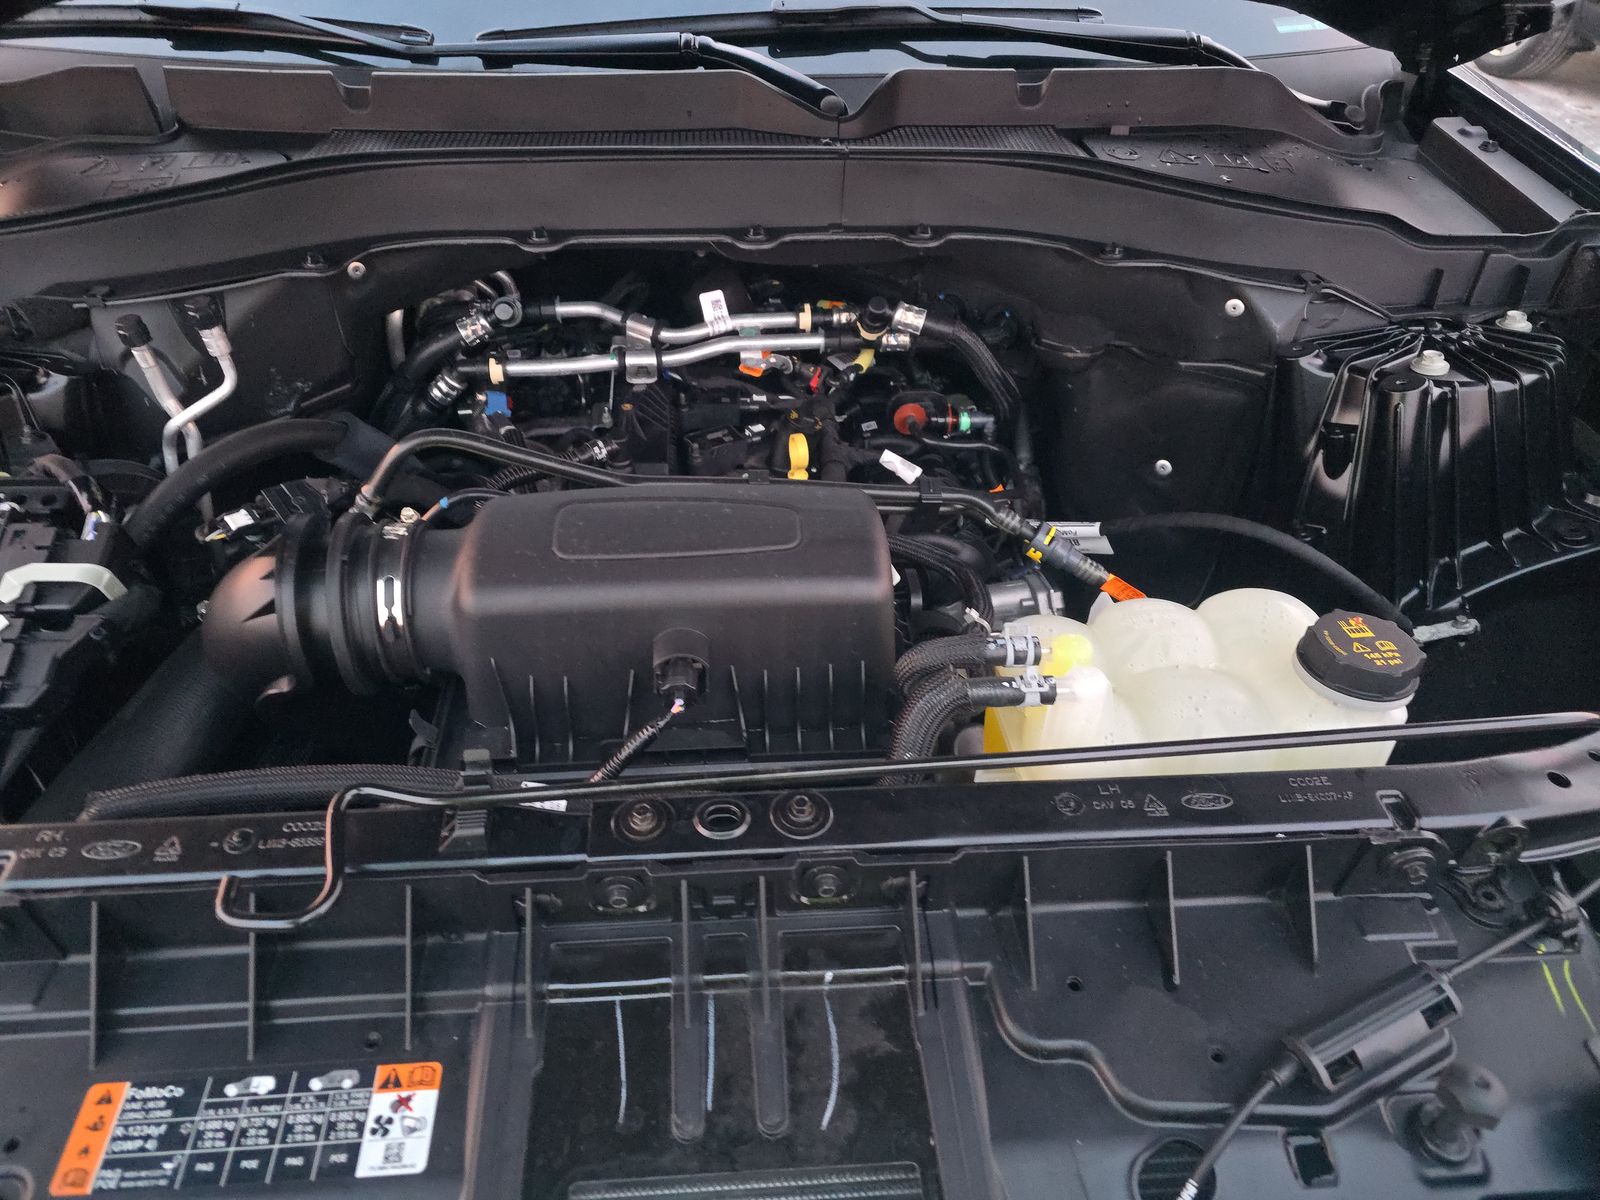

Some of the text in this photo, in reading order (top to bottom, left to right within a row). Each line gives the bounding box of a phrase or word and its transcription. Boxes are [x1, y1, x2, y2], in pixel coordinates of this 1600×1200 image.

[1096, 783, 1122, 796] LH
[1186, 793, 1229, 809] Ford
[127, 1085, 185, 1100] FoMoCo
